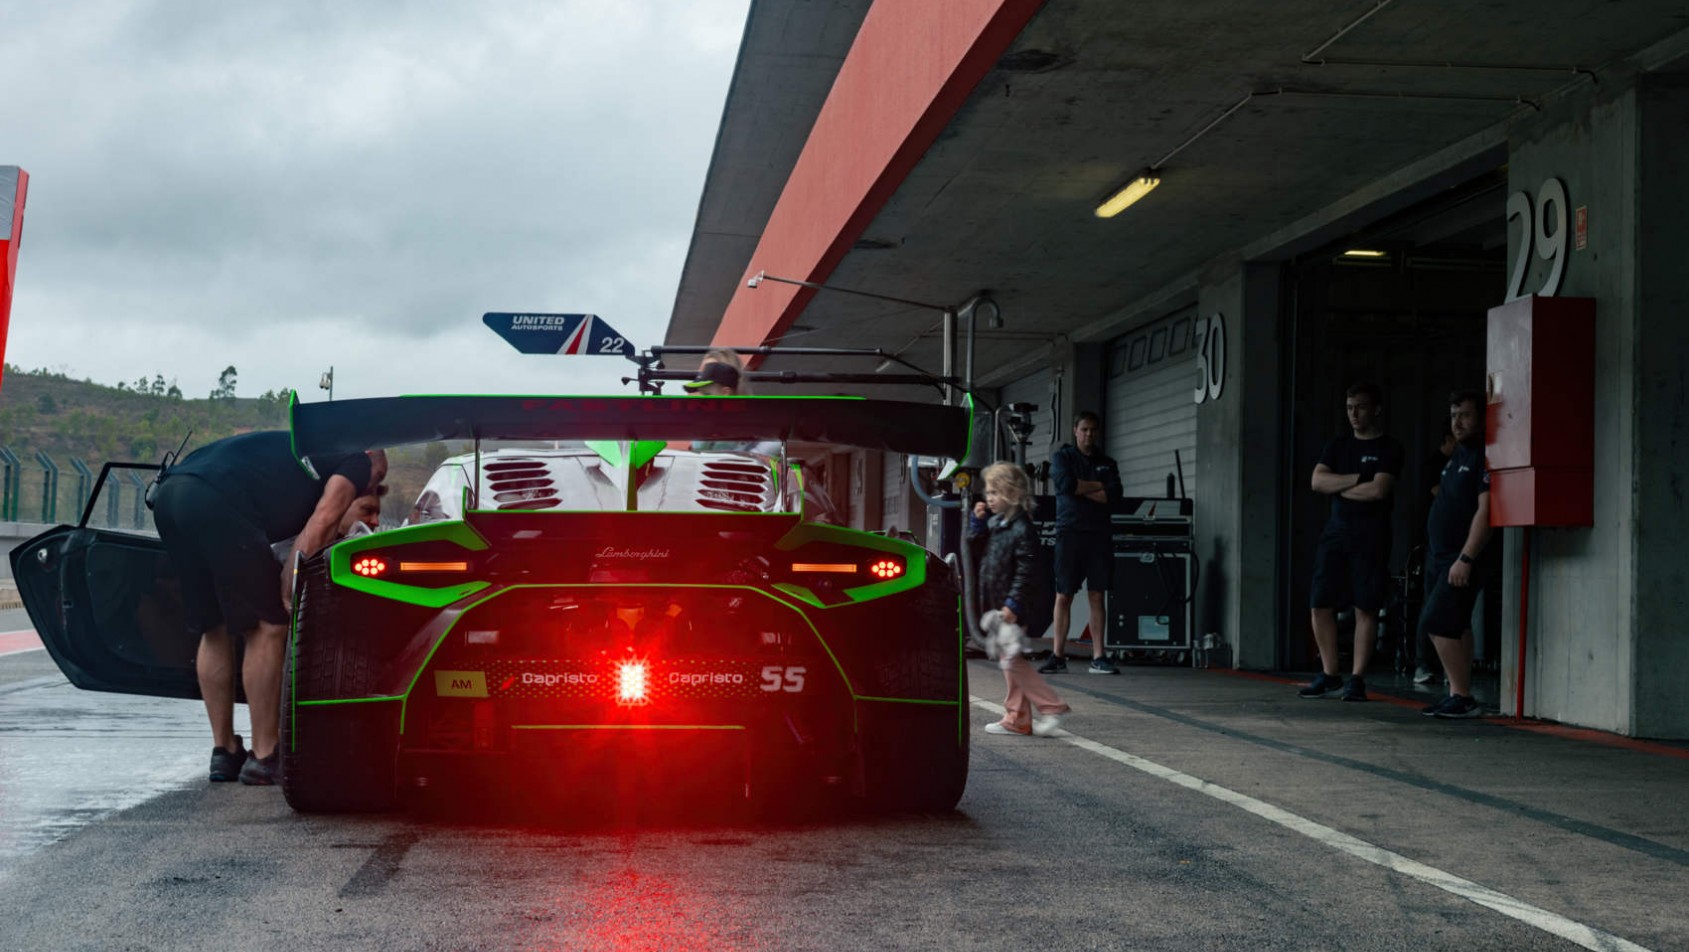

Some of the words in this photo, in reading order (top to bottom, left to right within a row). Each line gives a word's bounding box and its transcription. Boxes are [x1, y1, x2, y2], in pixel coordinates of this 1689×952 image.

[1503, 177, 1570, 304] 29
[512, 315, 565, 325] UNITED
[600, 336, 625, 353] 22
[1194, 313, 1226, 404] 30
[595, 546, 670, 560] Lamborghini
[451, 679, 472, 690] AM
[522, 672, 598, 686] Capristo
[669, 671, 743, 686] Capristo
